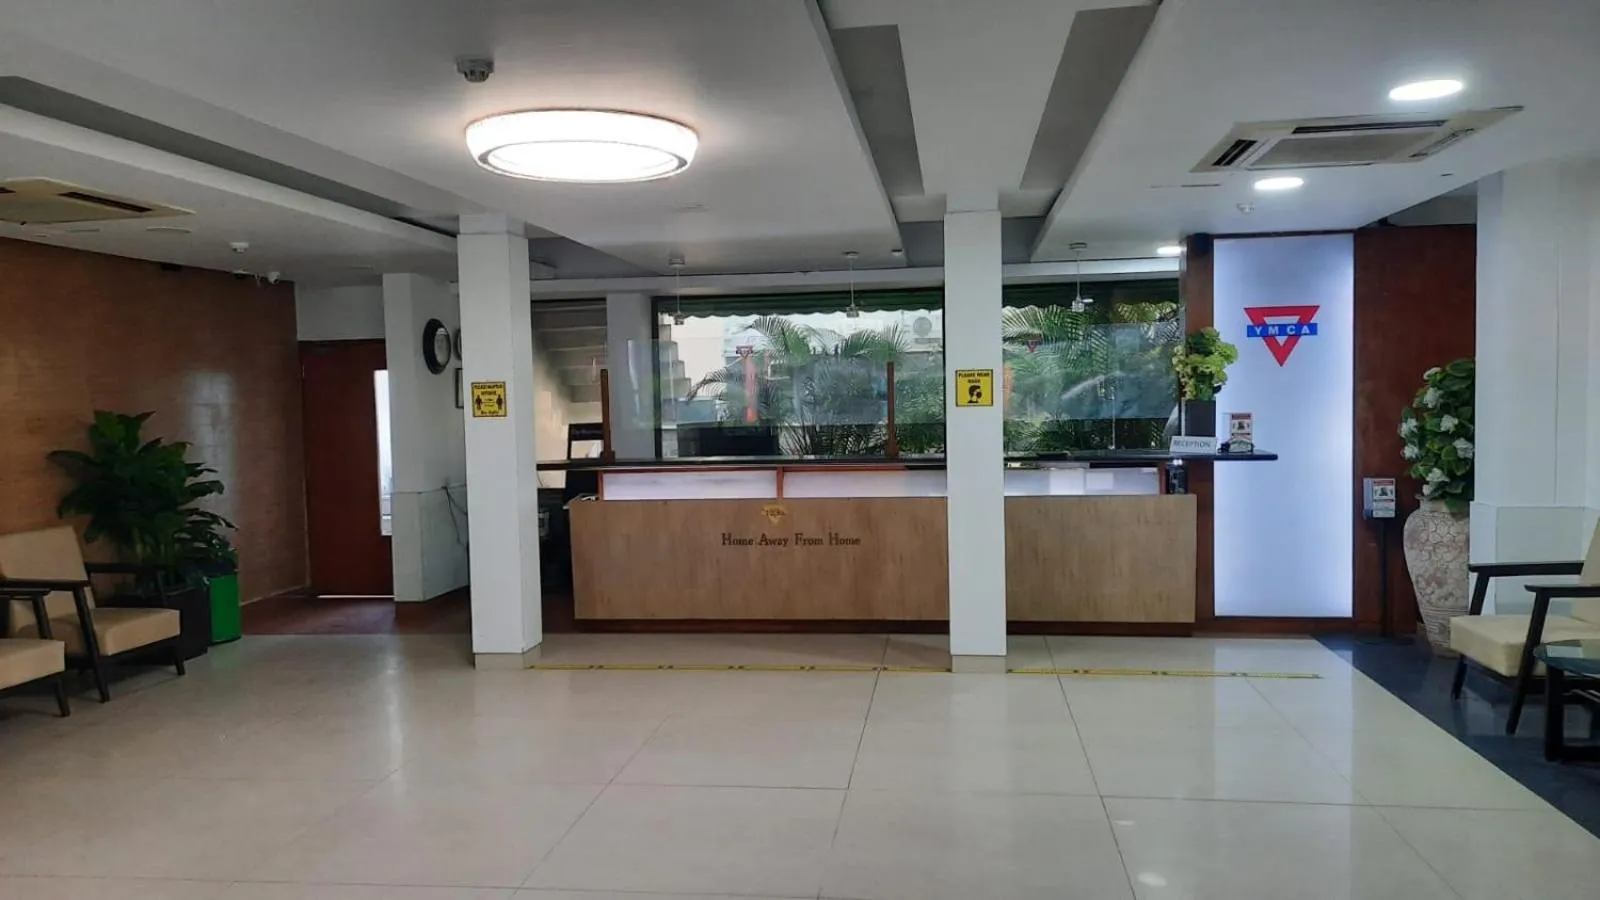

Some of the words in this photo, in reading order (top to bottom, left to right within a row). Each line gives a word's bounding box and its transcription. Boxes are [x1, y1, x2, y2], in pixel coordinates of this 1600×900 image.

[1254, 325, 1311, 336] YMCA
[1173, 439, 1212, 449] RECEPTION
[721, 532, 754, 546] Home
[759, 532, 789, 548] Away
[794, 532, 824, 546] From
[828, 532, 861, 546] Home
